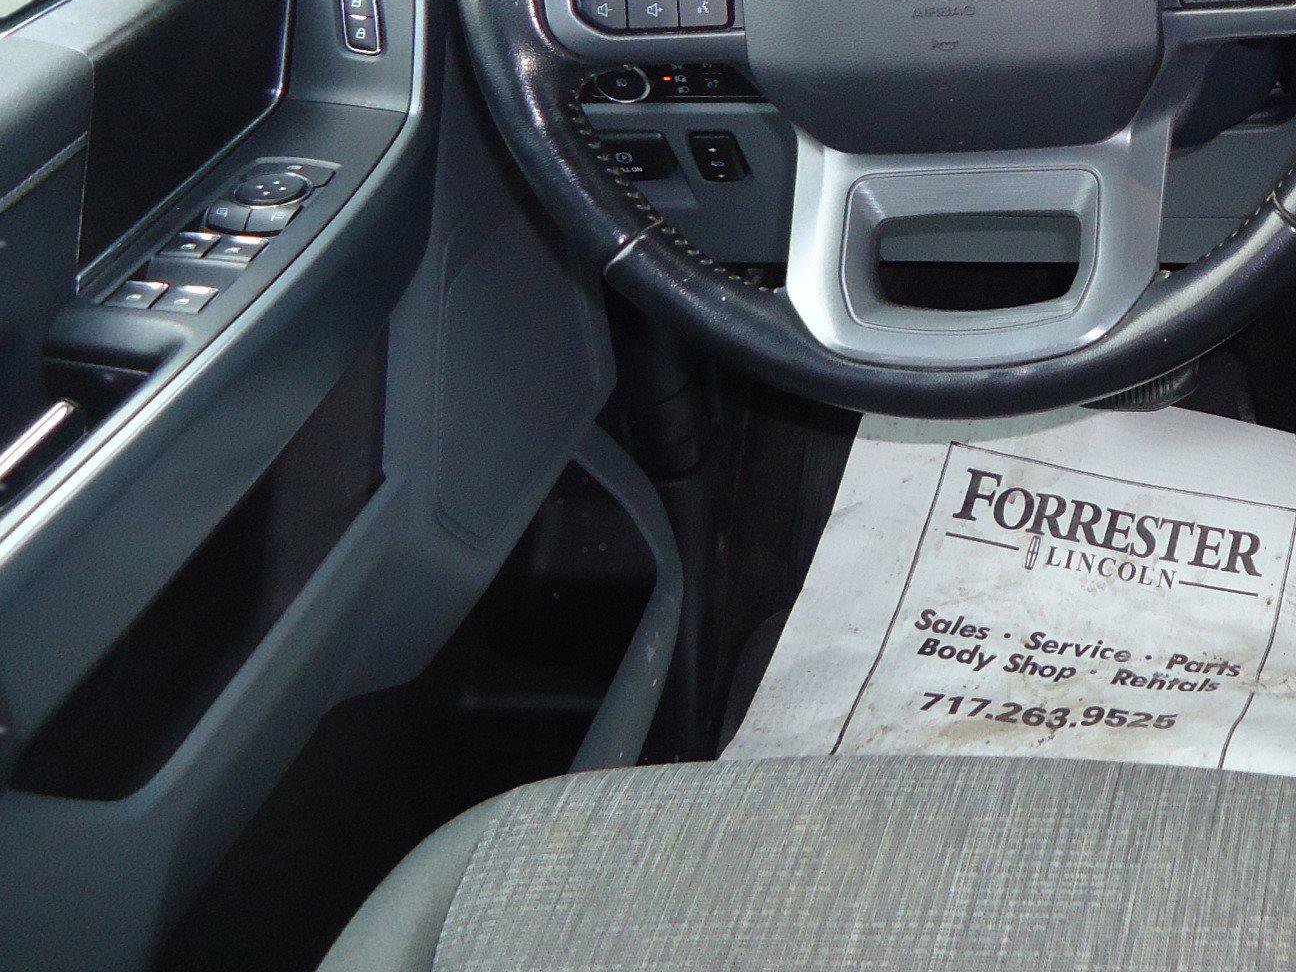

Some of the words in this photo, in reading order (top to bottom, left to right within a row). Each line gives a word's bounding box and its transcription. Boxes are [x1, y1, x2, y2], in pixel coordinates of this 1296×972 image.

[952, 467, 1262, 578] FORRESTER
[1046, 544, 1179, 590] LINCOLN
[914, 608, 990, 641] Sales
[1024, 631, 1131, 663] Service
[1166, 652, 1242, 679] Parts
[916, 638, 995, 672] Body
[1003, 653, 1076, 683] Shop
[1110, 668, 1222, 693] Rentals
[919, 692, 1178, 729] 717.263.9525
